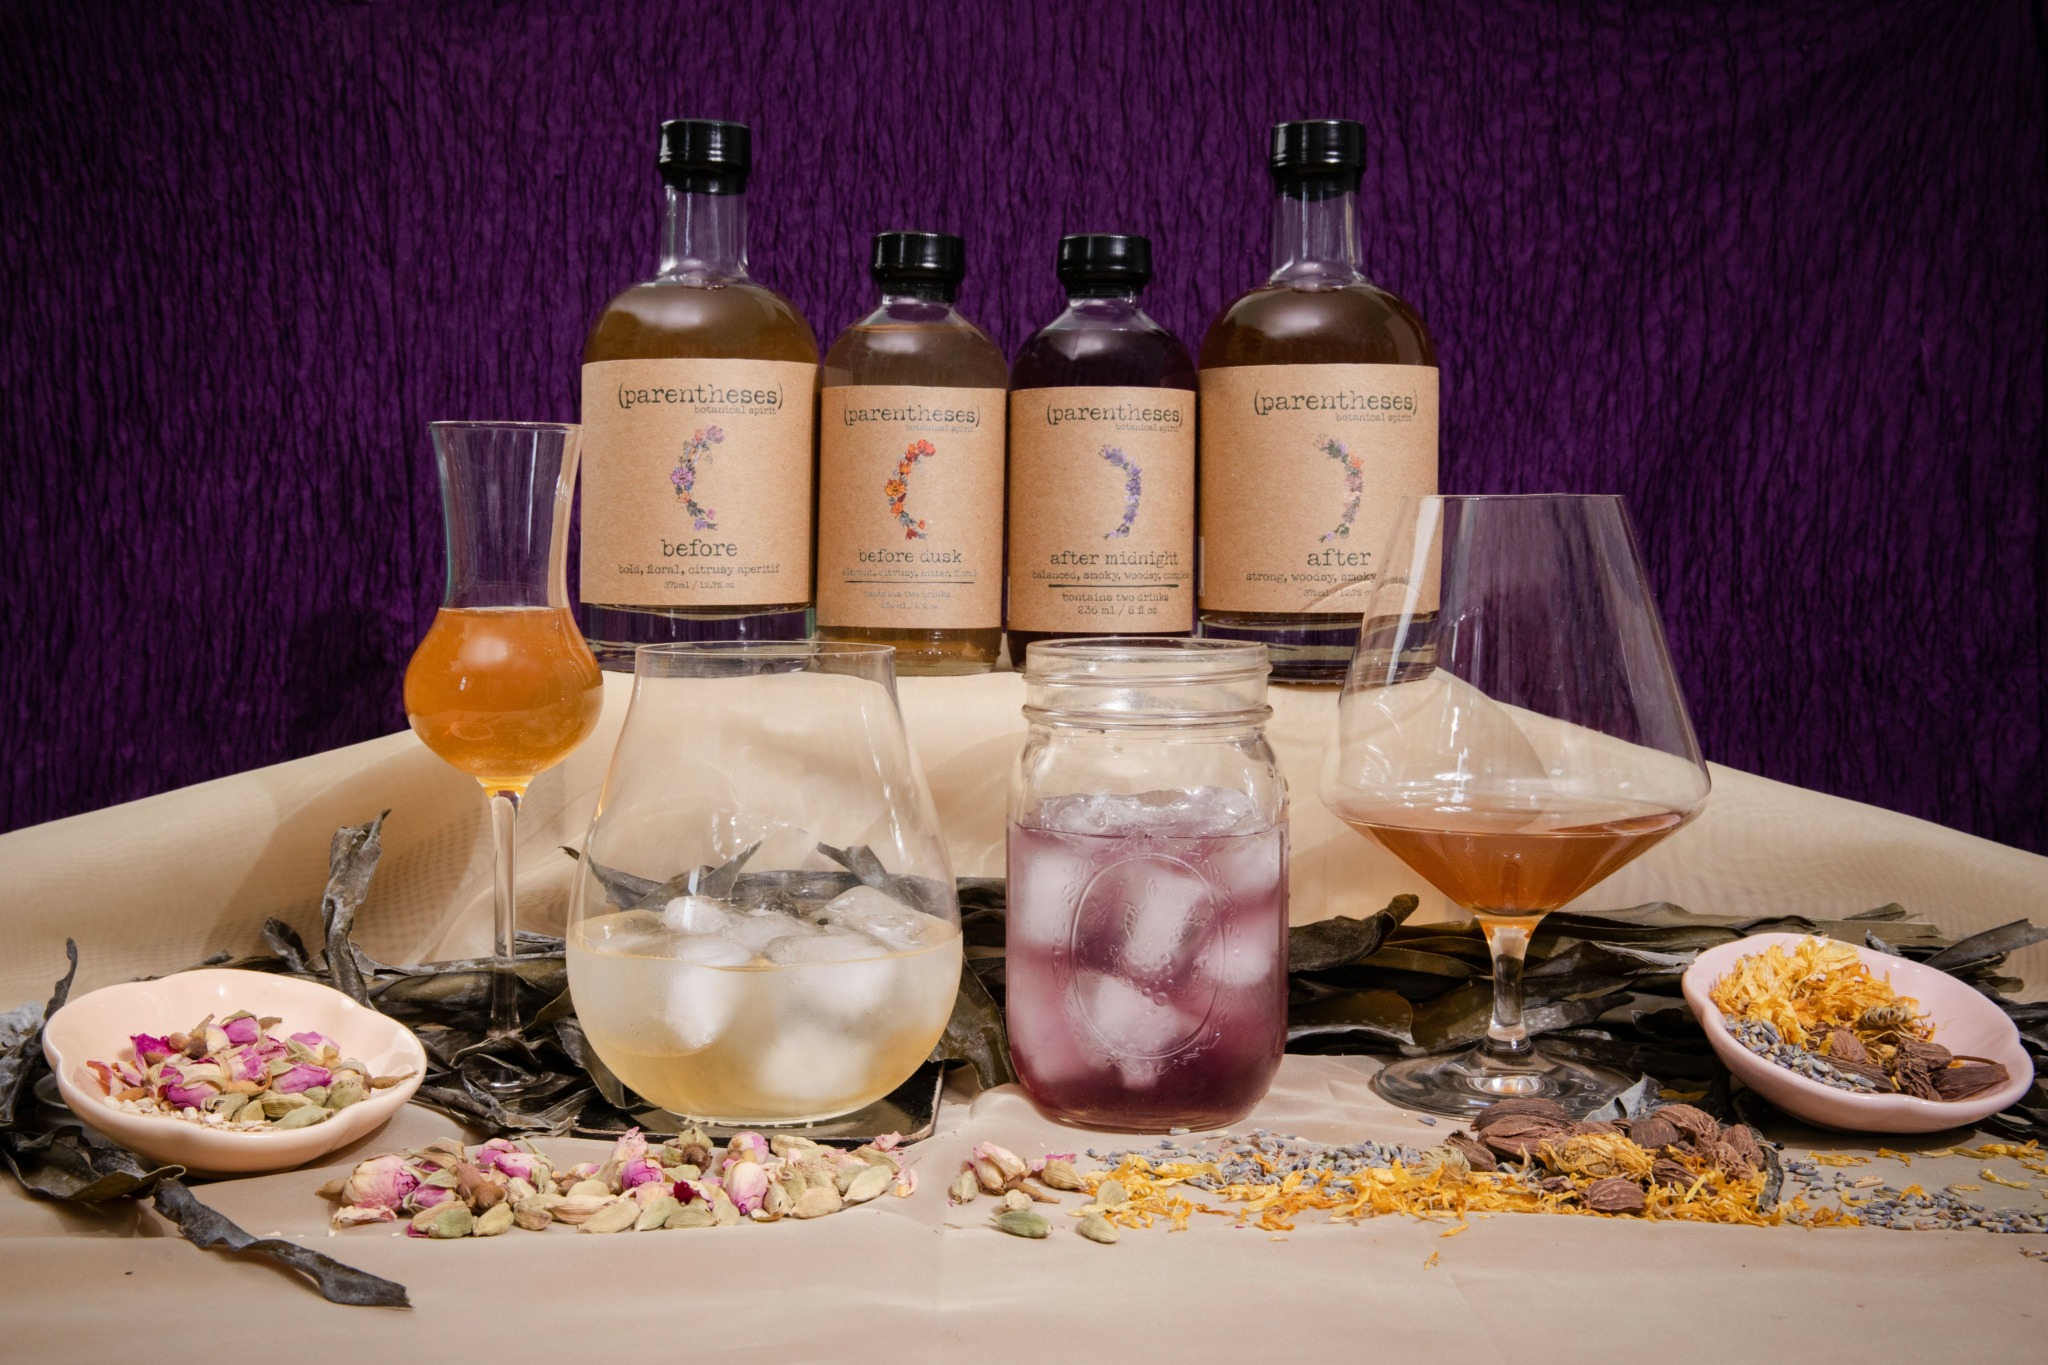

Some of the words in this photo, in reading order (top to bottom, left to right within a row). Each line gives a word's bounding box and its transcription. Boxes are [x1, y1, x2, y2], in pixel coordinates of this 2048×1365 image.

[618, 382, 784, 409] (parentheses)
[1254, 388, 1417, 415] (parentheses)
[694, 405, 746, 414] botanical
[748, 406, 777, 415] spirit
[844, 403, 981, 427] (parentheses)
[1047, 402, 1183, 427] (parentheses)
[1335, 413, 1385, 421] botanical
[1388, 413, 1411, 423] spirit
[661, 539, 738, 557] before
[858, 549, 914, 563] before
[920, 549, 962, 563] dusk
[1050, 551, 1099, 565] after
[1105, 551, 1179, 568] midnight
[1307, 548, 1371, 566] after
[618, 564, 643, 575] bold,
[647, 564, 685, 575] floral,
[688, 565, 733, 576] citrusy
[737, 565, 780, 575] aperitif
[1032, 570, 1080, 581] balanced,
[1083, 571, 1121, 581] smoky,
[1124, 571, 1162, 581] woodsy,
[1246, 573, 1287, 583] strong,
[1291, 573, 1337, 583] woodsy,
[1062, 593, 1112, 602] contains
[1116, 593, 1134, 602] two
[1137, 592, 1168, 602] drinks
[1078, 606, 1098, 614] 236
[1101, 606, 1114, 614] ml
[1128, 606, 1134, 614] 8
